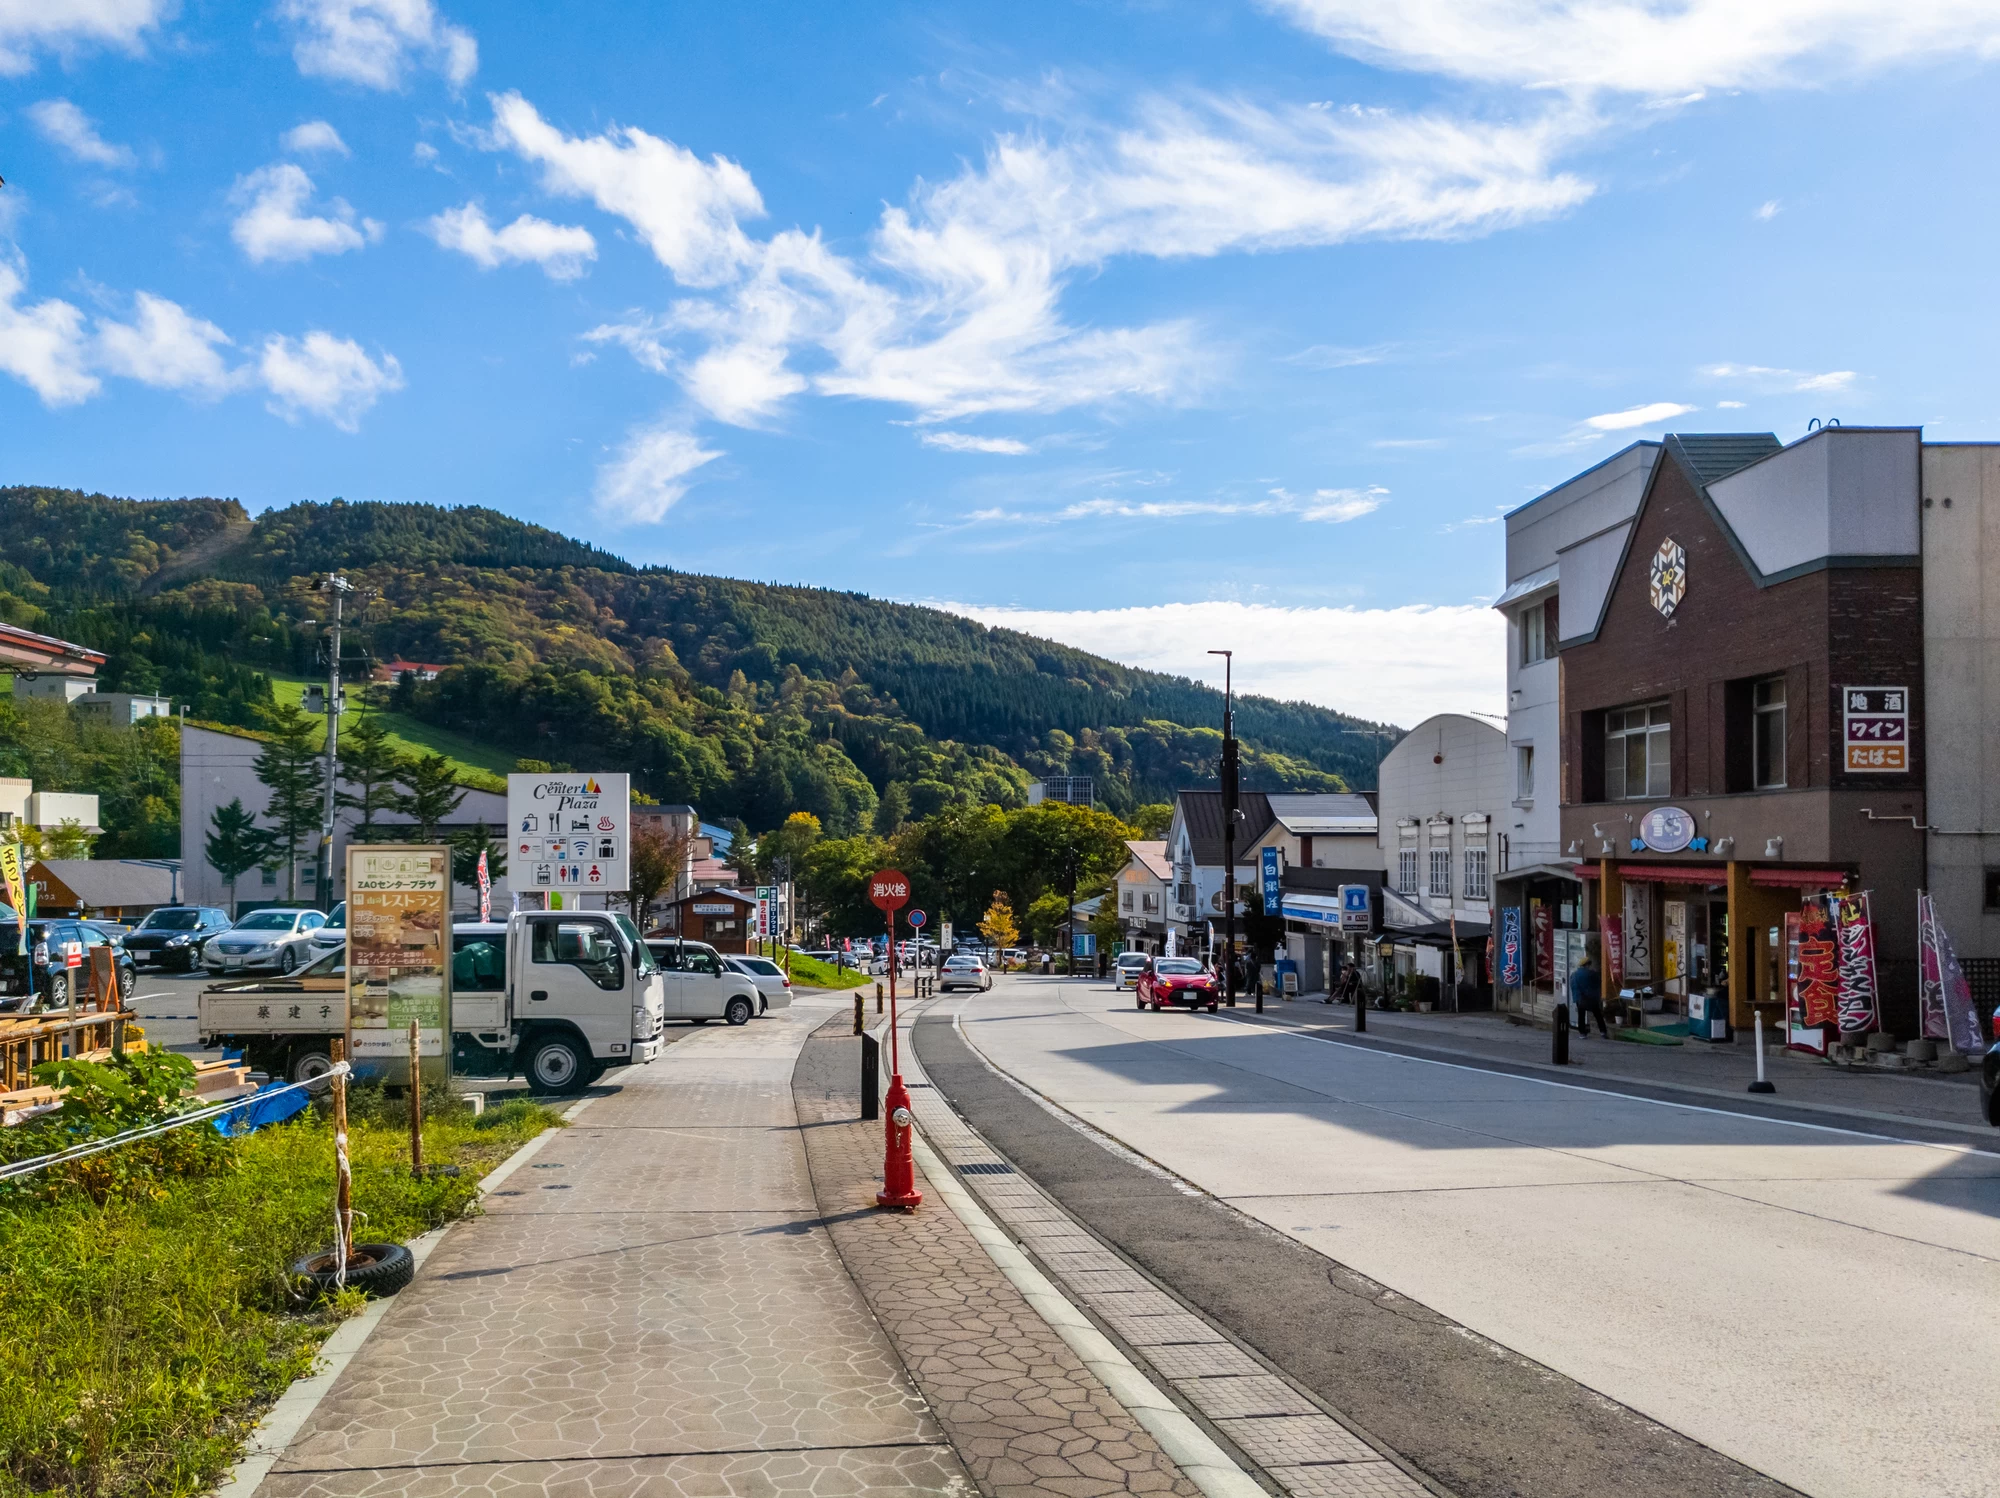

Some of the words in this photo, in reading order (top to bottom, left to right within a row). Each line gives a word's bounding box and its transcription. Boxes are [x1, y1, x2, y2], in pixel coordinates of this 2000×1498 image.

[1850, 693, 1902, 710] 地酒
[1851, 722, 1901, 738] ワイン
[1851, 749, 1901, 765] たばこ
[533, 783, 581, 800] Center
[557, 796, 598, 811] Plaza
[357, 880, 437, 889] ZAOセンタープラザ
[873, 882, 907, 897] 消火栓
[1264, 864, 1279, 909] 白銀荘
[366, 894, 442, 907] 山のレストラン
[759, 889, 768, 898] P
[1535, 911, 1551, 977] ラーメン
[1797, 936, 1840, 1026] 定食
